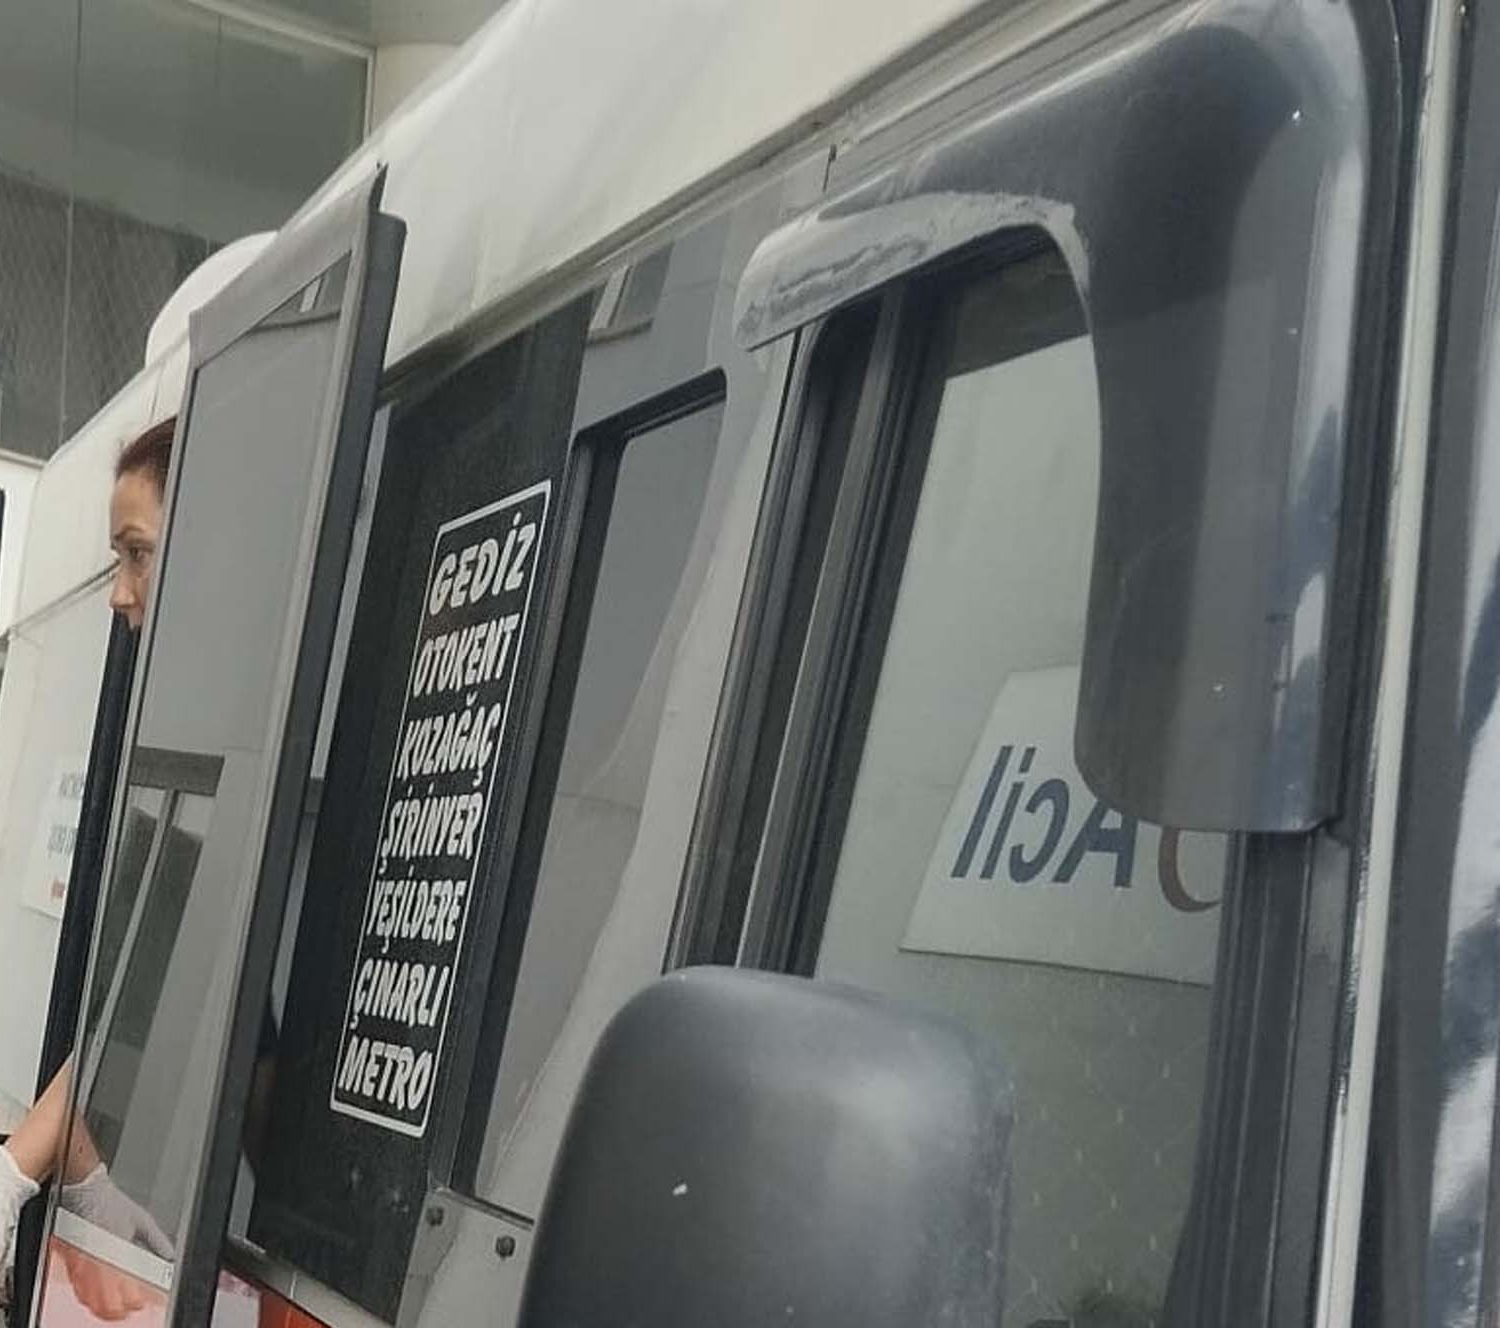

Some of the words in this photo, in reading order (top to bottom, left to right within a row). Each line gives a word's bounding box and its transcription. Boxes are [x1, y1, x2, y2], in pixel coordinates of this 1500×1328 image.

[428, 511, 536, 616] GEDİZ
[412, 613, 521, 699] OTOKENT
[396, 691, 501, 787] KOZAĞAÇ
[378, 783, 484, 875] ŞİRİNYER
[366, 864, 468, 953] YEŞİLDERE
[350, 957, 451, 1030] ÇINARLI
[338, 1034, 434, 1111] METRO
